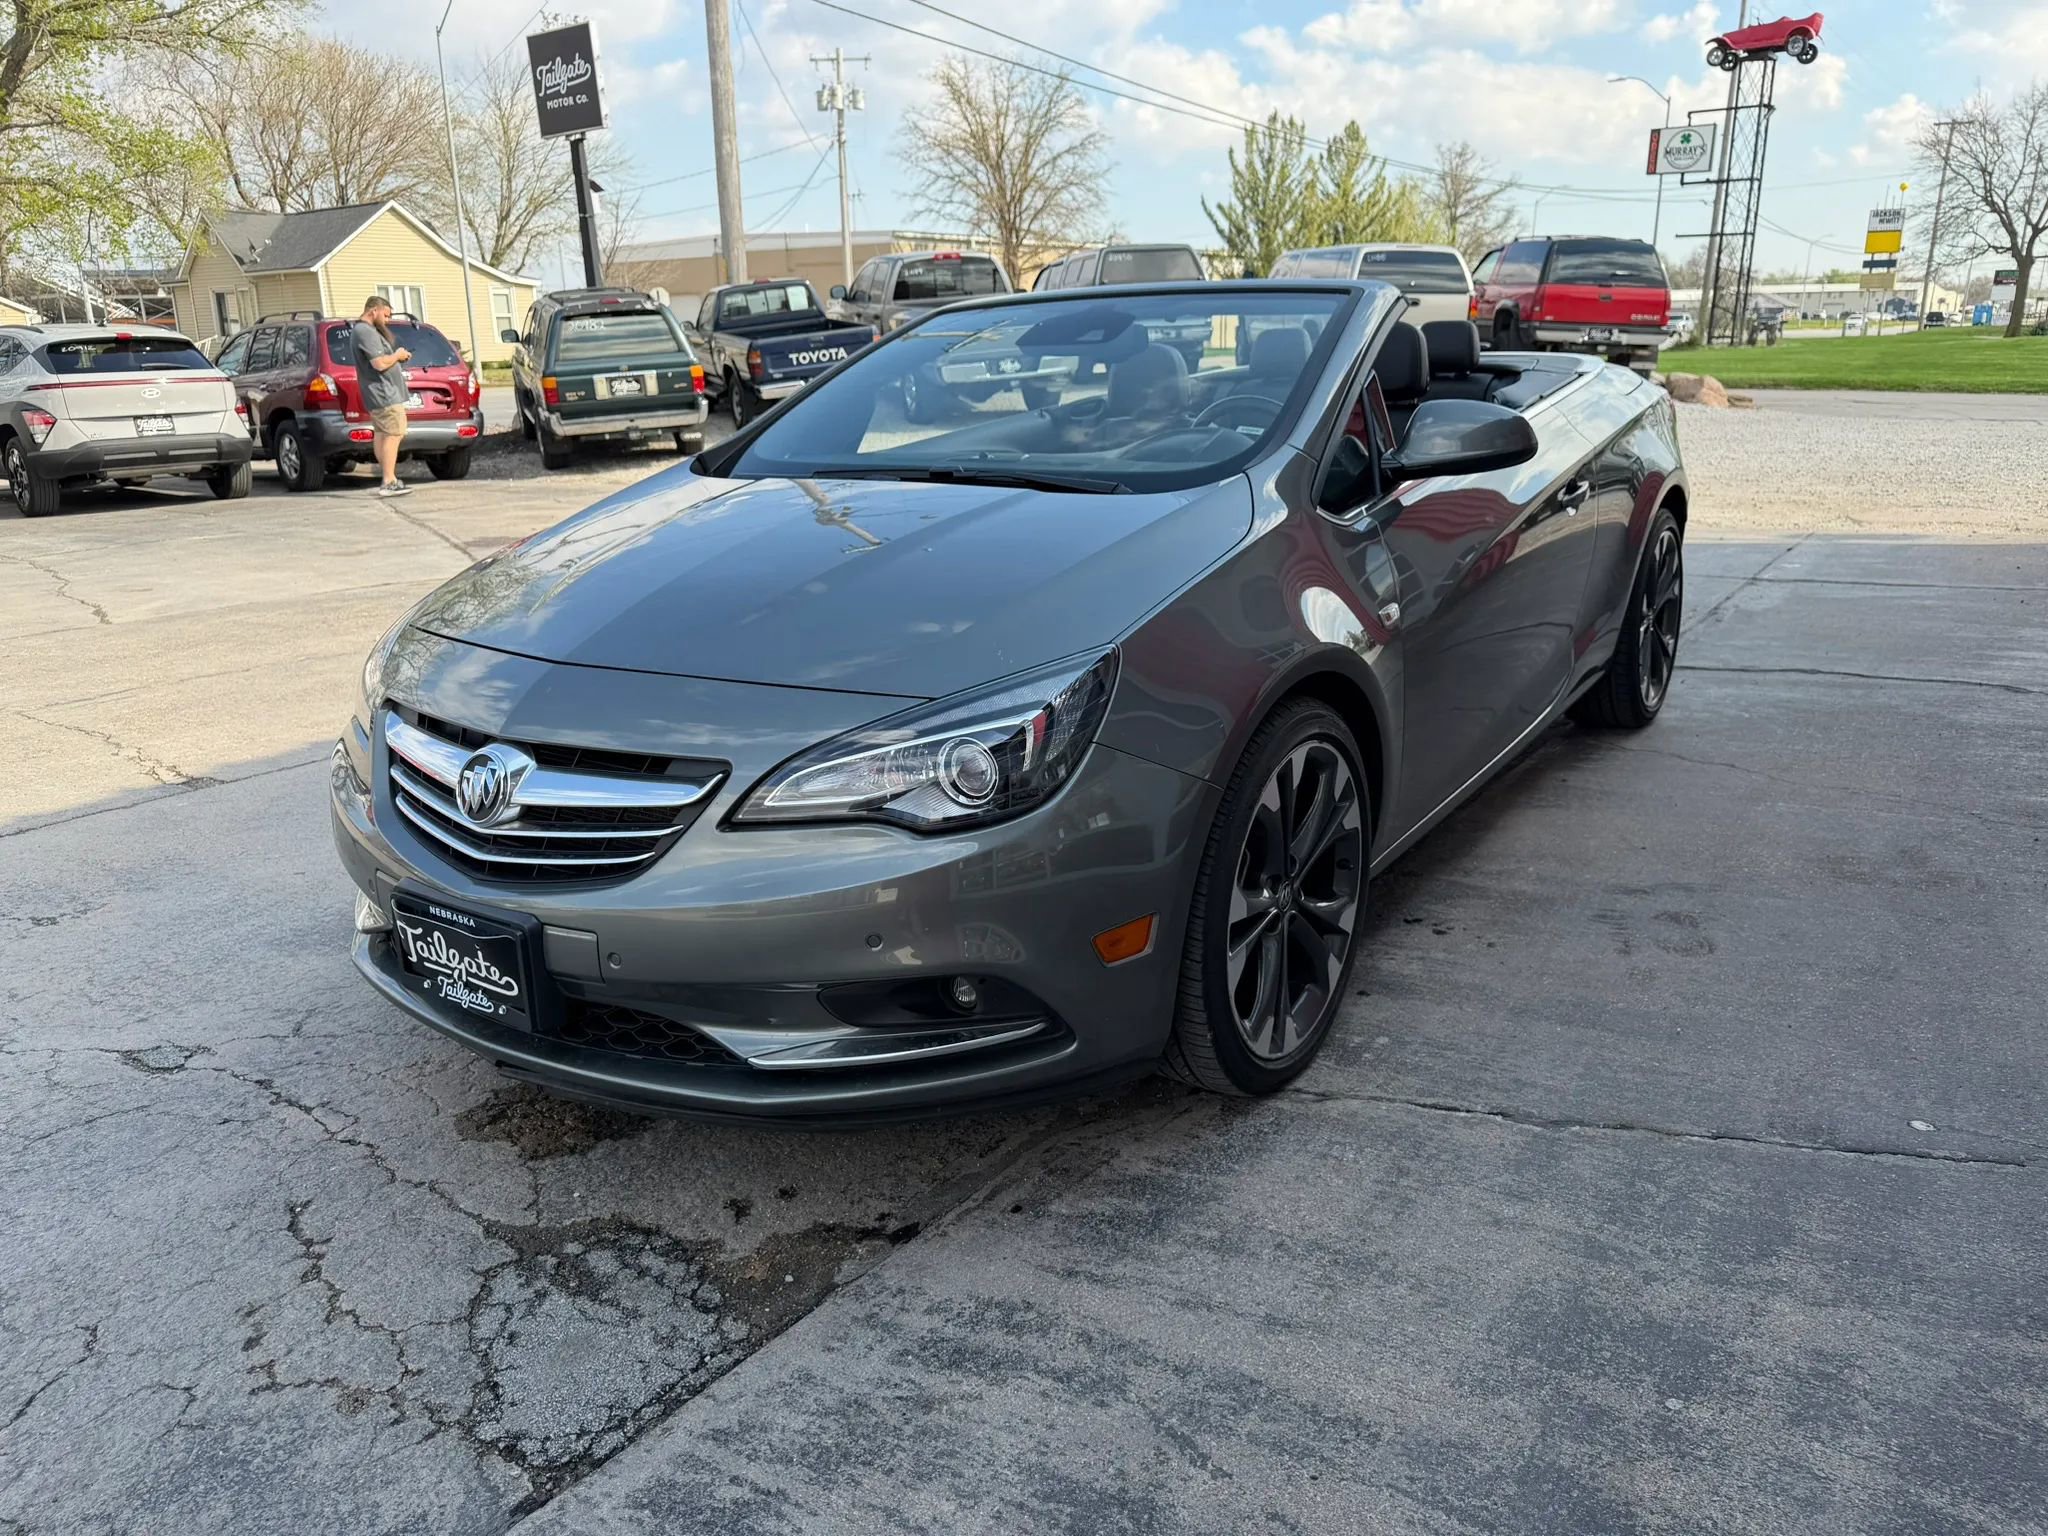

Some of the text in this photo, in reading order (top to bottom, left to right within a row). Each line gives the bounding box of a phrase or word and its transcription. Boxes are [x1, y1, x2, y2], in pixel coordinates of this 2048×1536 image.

[536, 52, 592, 97] Tailgate
[546, 96, 574, 110] MOTOR
[1872, 208, 1902, 218] JACKSON
[788, 346, 848, 366] TOYOTA
[429, 905, 476, 928] NEBRASKA
[396, 919, 519, 997] Tailgate
[437, 976, 495, 1013] Tailgate
